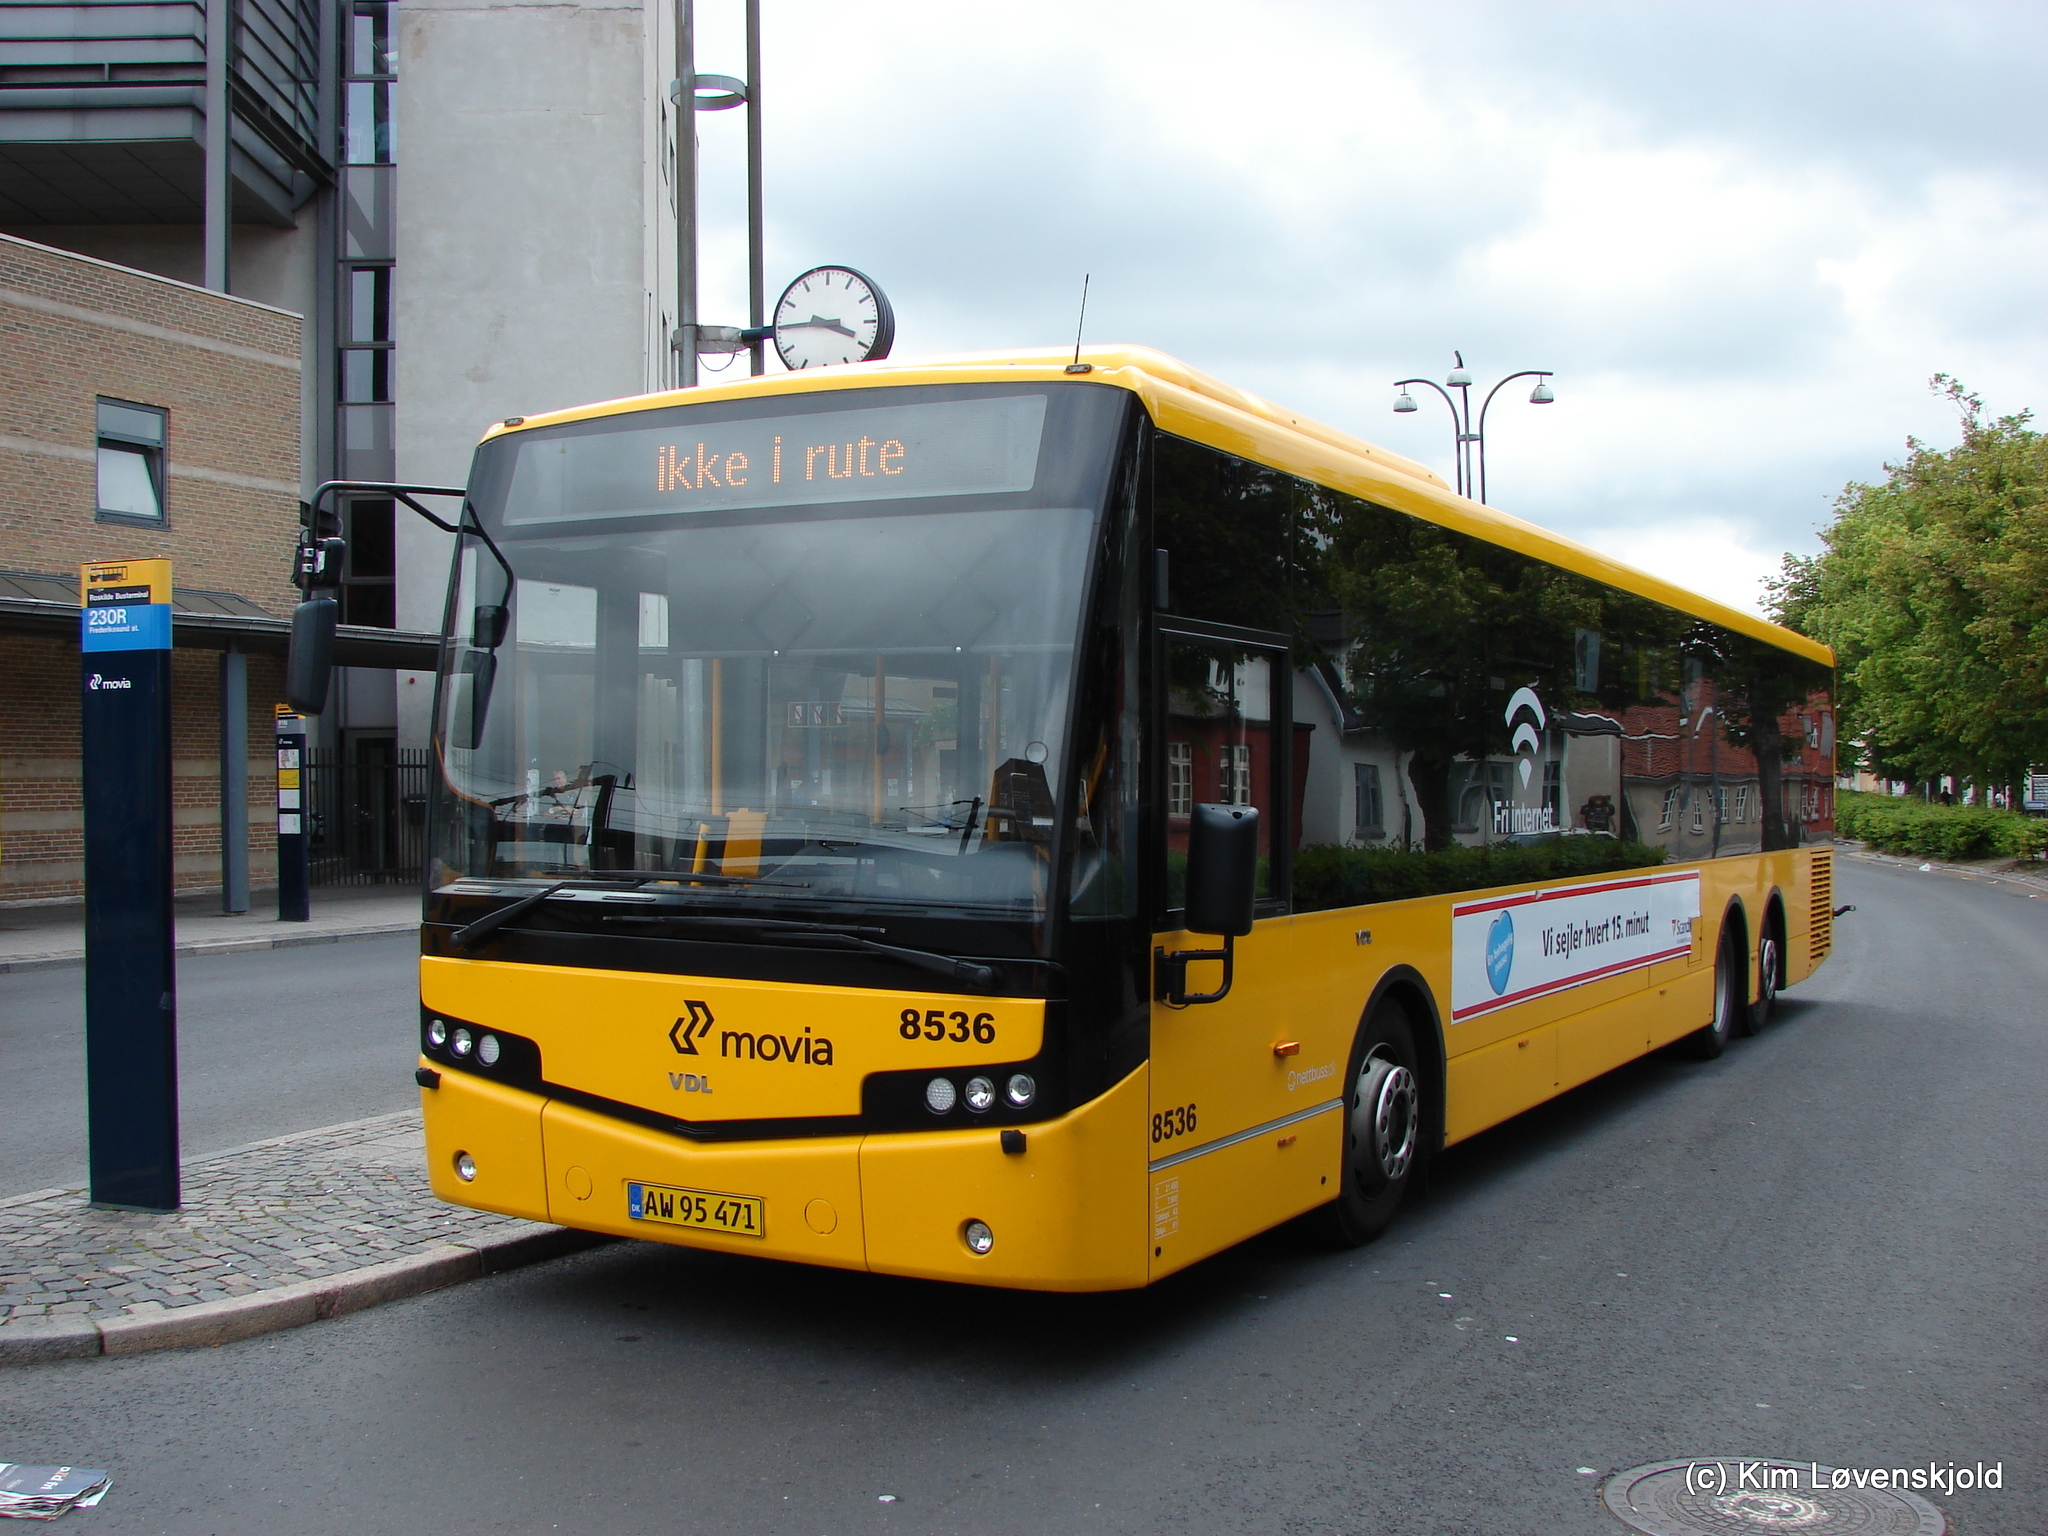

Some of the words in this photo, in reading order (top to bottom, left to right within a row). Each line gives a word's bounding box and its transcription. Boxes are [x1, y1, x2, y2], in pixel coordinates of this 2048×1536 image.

[658, 442, 749, 491] ikke
[773, 435, 782, 483] i
[806, 435, 904, 480] rute
[89, 609, 127, 625] 230R
[102, 677, 132, 690] movia
[1494, 801, 1509, 834] Fri
[1511, 801, 1553, 833] internet
[1542, 927, 1553, 957] Vi
[1555, 922, 1583, 960] sejler
[1585, 919, 1610, 947] hvert
[1611, 915, 1624, 940] 15.
[1625, 911, 1650, 938] minut
[900, 1008, 996, 1044] 8536
[721, 1026, 833, 1066] movia
[668, 1071, 713, 1094] VDL
[1151, 1103, 1197, 1144] 8536
[631, 1203, 641, 1213] DK
[644, 1190, 674, 1218] AW
[679, 1195, 707, 1222] 95
[714, 1200, 755, 1230] 471
